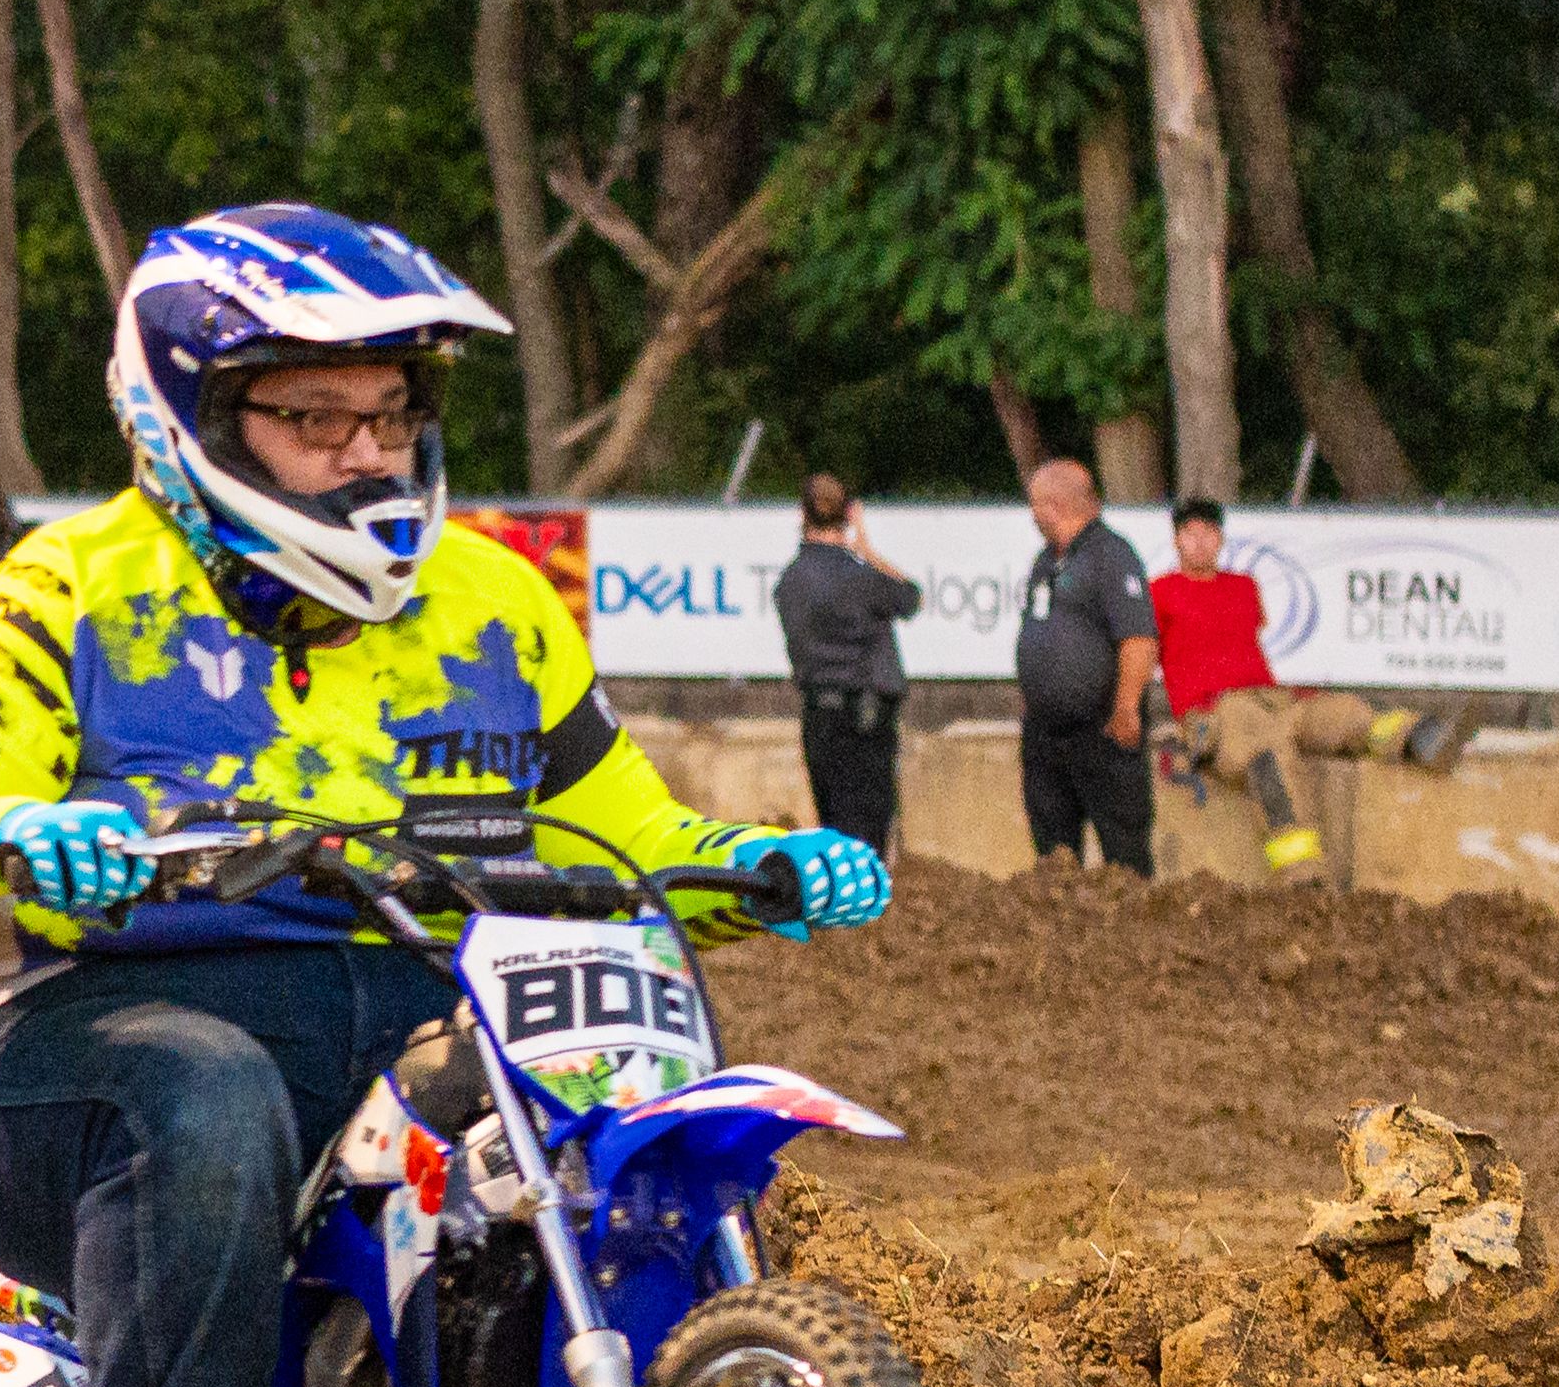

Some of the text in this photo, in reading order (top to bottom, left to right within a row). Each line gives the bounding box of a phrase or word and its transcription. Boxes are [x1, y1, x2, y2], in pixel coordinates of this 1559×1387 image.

[595, 564, 742, 615] DELL
[1346, 570, 1461, 605] DEAN
[394, 729, 551, 790] THOR
[498, 961, 701, 1046] 808
